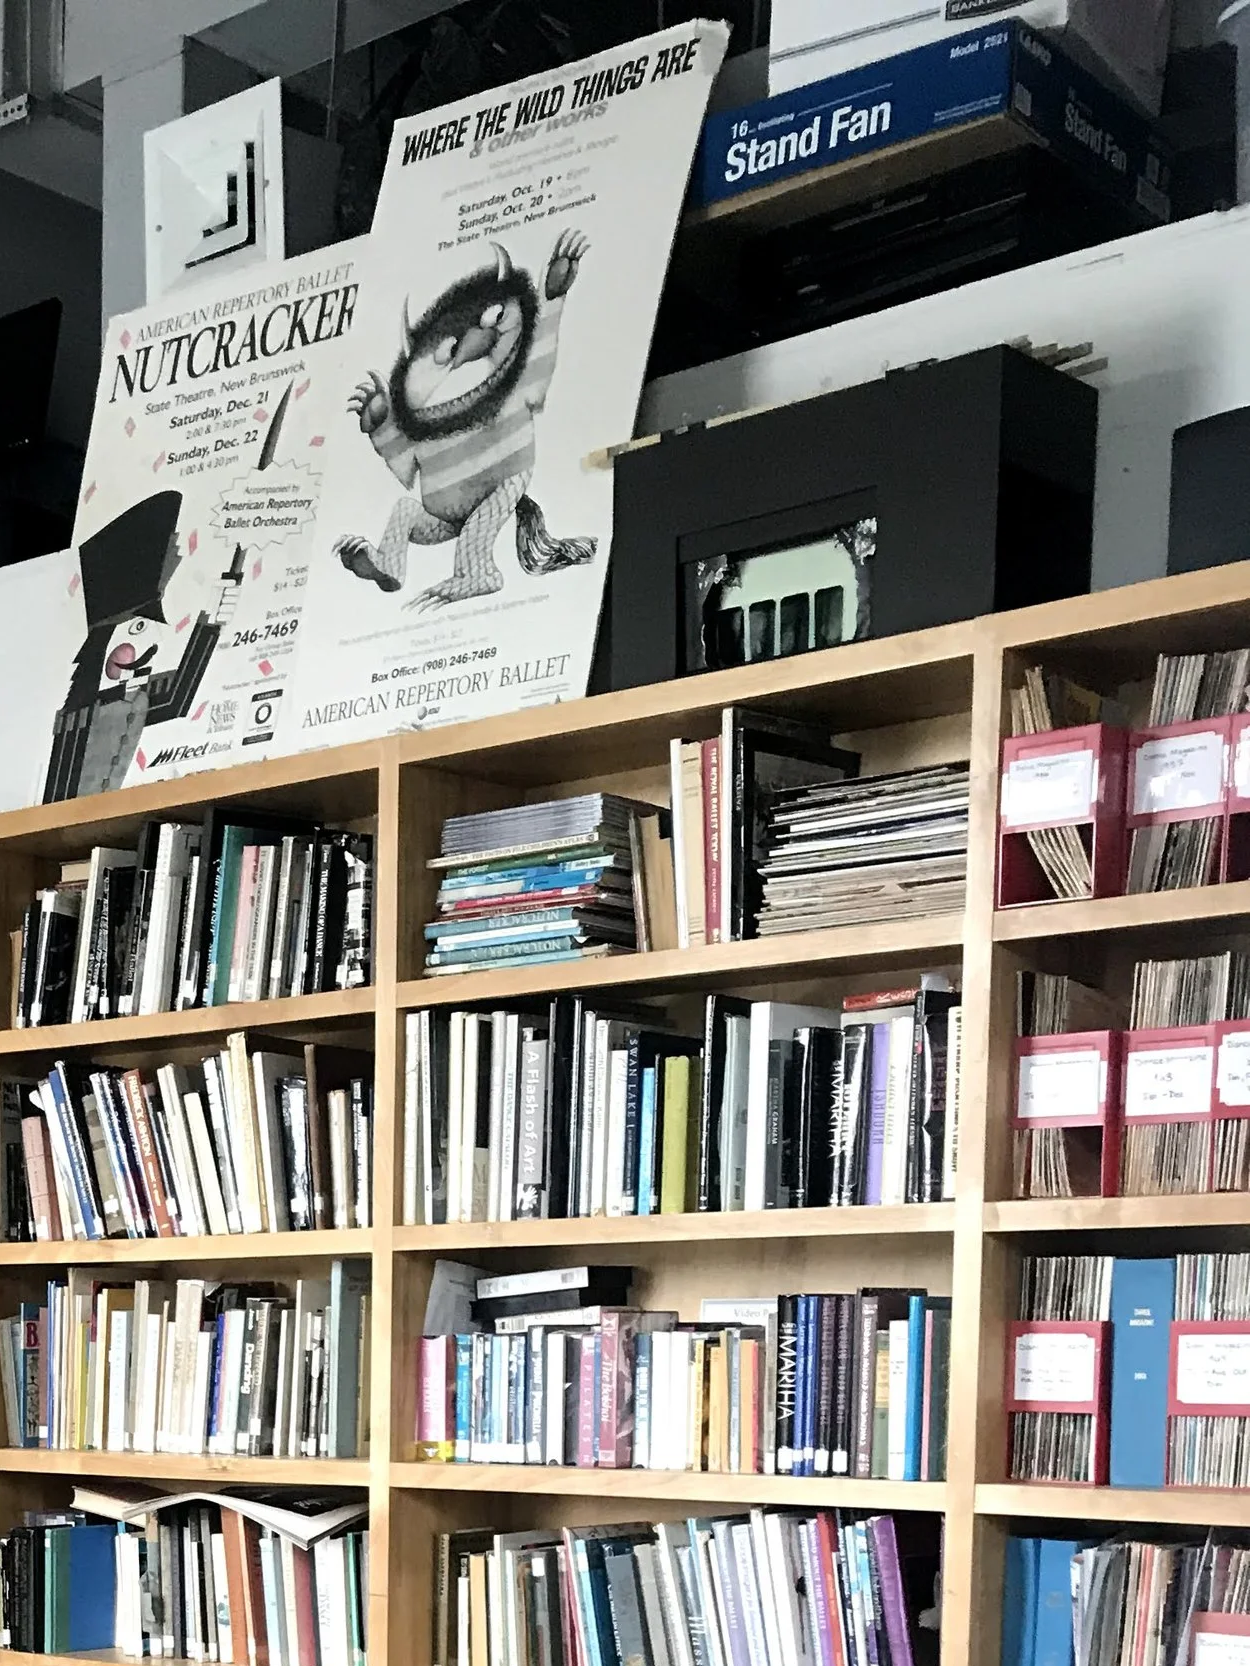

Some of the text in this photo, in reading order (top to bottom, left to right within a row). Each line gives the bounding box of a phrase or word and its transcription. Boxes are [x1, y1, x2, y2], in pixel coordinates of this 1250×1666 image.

[950, 40, 979, 59] Model
[402, 115, 471, 166] WHERE
[473, 102, 511, 142] THE
[514, 84, 566, 129] WILD
[571, 55, 650, 109] THINGS
[650, 37, 702, 83] ARE
[488, 122, 538, 151] other
[545, 101, 608, 134] works
[724, 116, 821, 182] Stand
[829, 101, 892, 148] Fan
[458, 175, 553, 216] Saturday, Oct. 19
[458, 194, 544, 231] Sunday, Oct. 20
[438, 238, 454, 251] The
[456, 232, 481, 246] State
[523, 208, 546, 225] New
[547, 192, 597, 216] Brunswick
[137, 262, 355, 344] AMERICAN REPERTORY BALLET
[109, 283, 360, 403] NUTCRACKER
[144, 360, 306, 416] State Theatre, New Brunswick
[168, 390, 269, 430] Saturday, Dec. 21
[166, 429, 259, 466] Sunday, Dec. 22
[221, 497, 313, 512] American Repertory
[224, 515, 298, 529] Ballet Orchestra
[232, 619, 299, 648] 246-7469
[371, 672, 389, 684] Box
[391, 665, 420, 680] Office:
[422, 657, 447, 675] (908)
[450, 647, 497, 667] 246-7469
[302, 692, 392, 729] AMERICAN
[395, 669, 495, 709] REPERTORY
[499, 654, 571, 688] BALLET
[172, 740, 210, 761] Fleet
[710, 797, 719, 829] BALLET
[319, 869, 329, 885] THE
[318, 886, 328, 914] MAKING
[315, 934, 325, 957] DANCE
[627, 1039, 638, 1118] SWAN LAKE
[128, 1075, 152, 1157] FREDERICK ASHTON
[523, 1052, 539, 1173] A Flash of Art
[771, 1111, 779, 1145] GRAHAM
[240, 1343, 255, 1395] Dancing
[600, 1361, 612, 1421] The Bolshoi
[777, 1335, 797, 1419] MARTHA
[583, 1365, 594, 1443] PILATES
